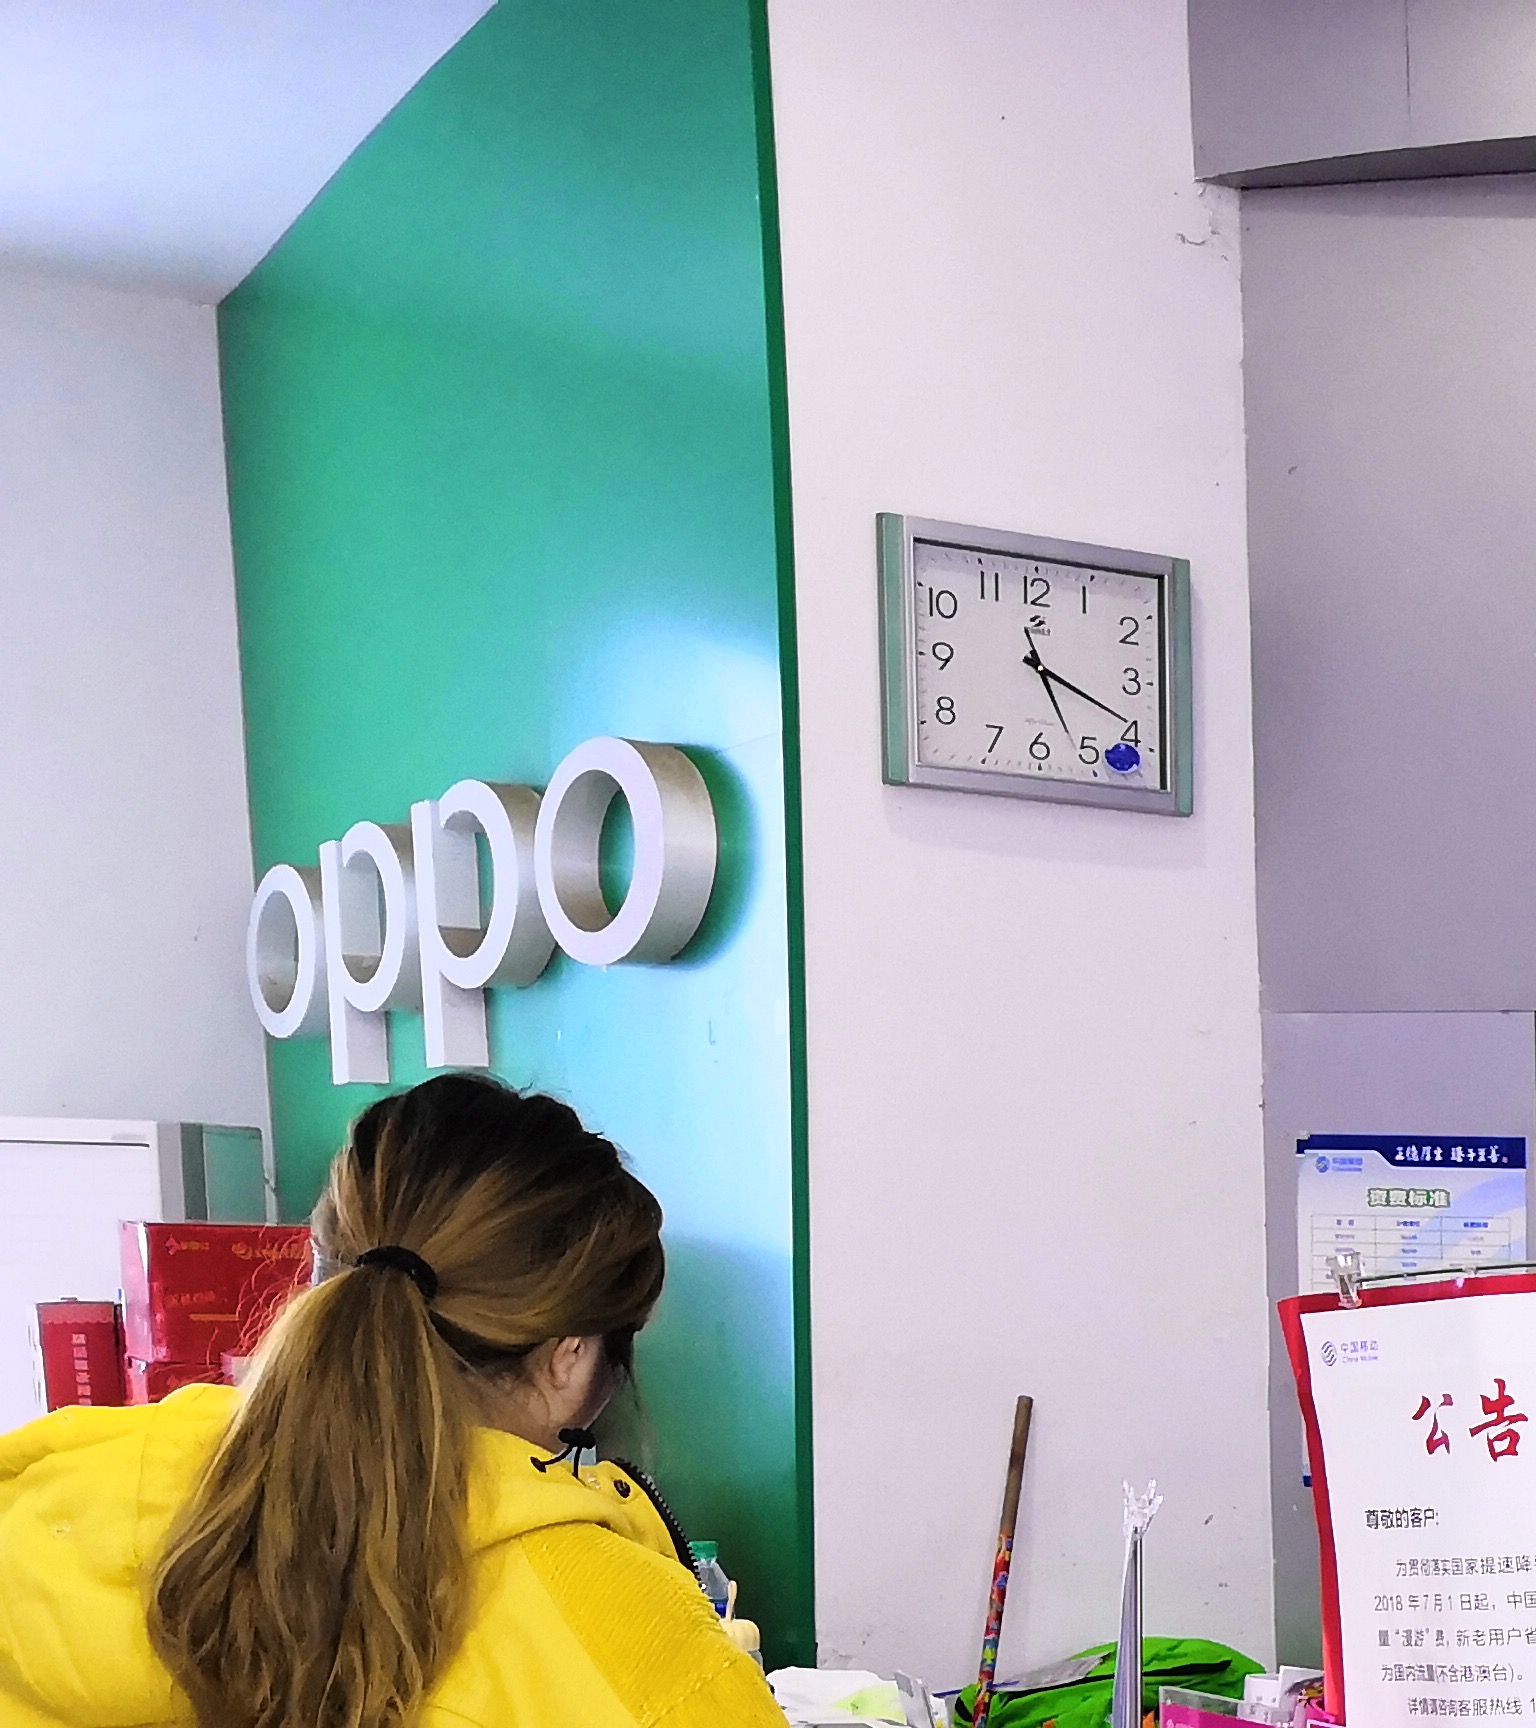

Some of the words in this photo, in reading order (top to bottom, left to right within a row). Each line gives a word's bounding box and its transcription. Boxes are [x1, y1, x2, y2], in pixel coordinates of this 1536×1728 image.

[928, 587, 958, 619] 10
[1023, 575, 1051, 607] 12
[1118, 616, 1140, 646] 2
[931, 641, 954, 670] 9
[1121, 667, 1141, 695] 3
[935, 696, 956, 724] 8
[985, 723, 1004, 753] 7
[1029, 732, 1051, 760] 6
[1120, 720, 1141, 748] 4
[1078, 736, 1100, 765] 5
[247, 737, 700, 1086] oppo
[1412, 1379, 1528, 1462] 公告
